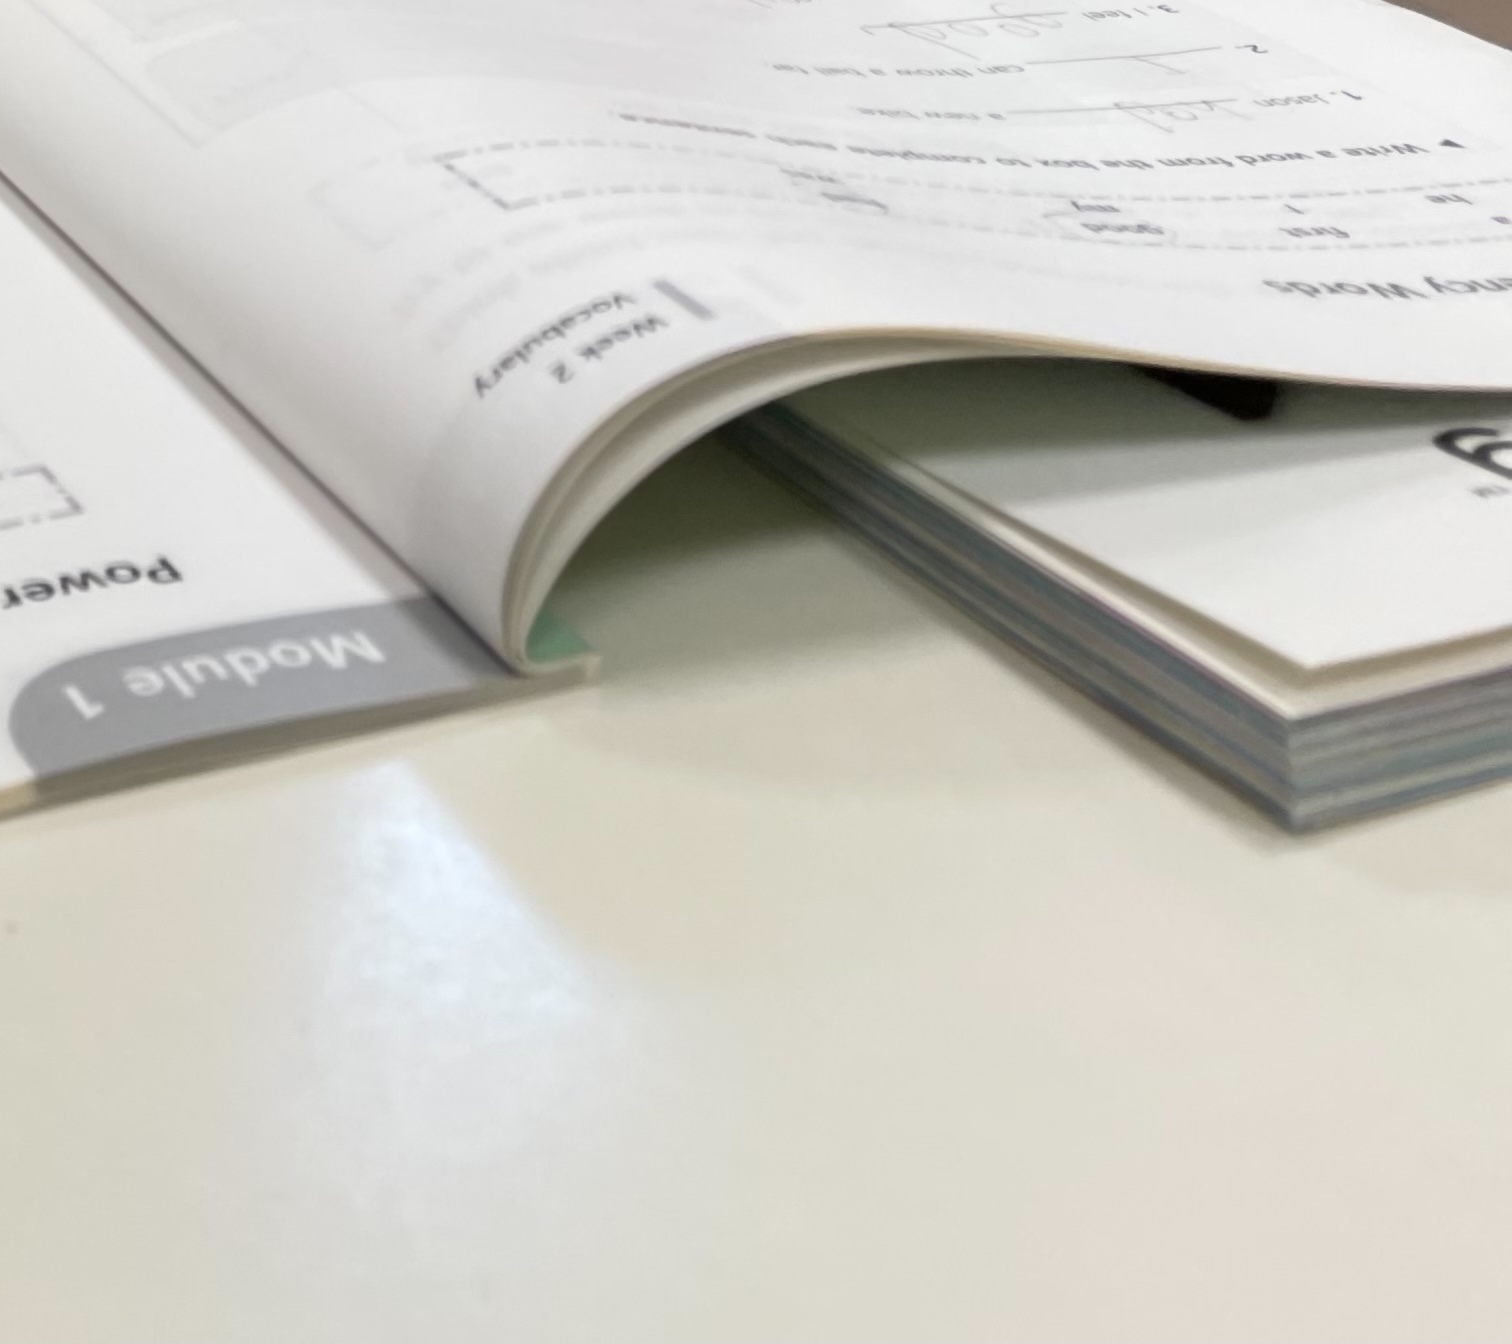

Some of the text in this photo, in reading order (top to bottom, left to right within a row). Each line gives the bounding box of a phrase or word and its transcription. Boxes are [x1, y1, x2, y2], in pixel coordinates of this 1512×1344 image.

[1081, 9, 1132, 21] feel
[1147, 4, 1181, 14] 3.
[1234, 44, 1269, 54] 2.
[977, 64, 1026, 75] can
[1253, 93, 1329, 107] Jason
[1329, 90, 1364, 101] 1.
[1315, 149, 1338, 158] a
[1341, 143, 1431, 157] Write
[995, 157, 1032, 167] to
[1034, 159, 1100, 171] box
[1099, 159, 1155, 170] the
[1156, 156, 1234, 167] from
[1235, 152, 1314, 166] word
[1260, 279, 1429, 300] Words
[473, 291, 638, 399] Vocabulary
[548, 314, 669, 384] Week 2
[1, 553, 184, 610] Power
[62, 630, 387, 721] Module 1
